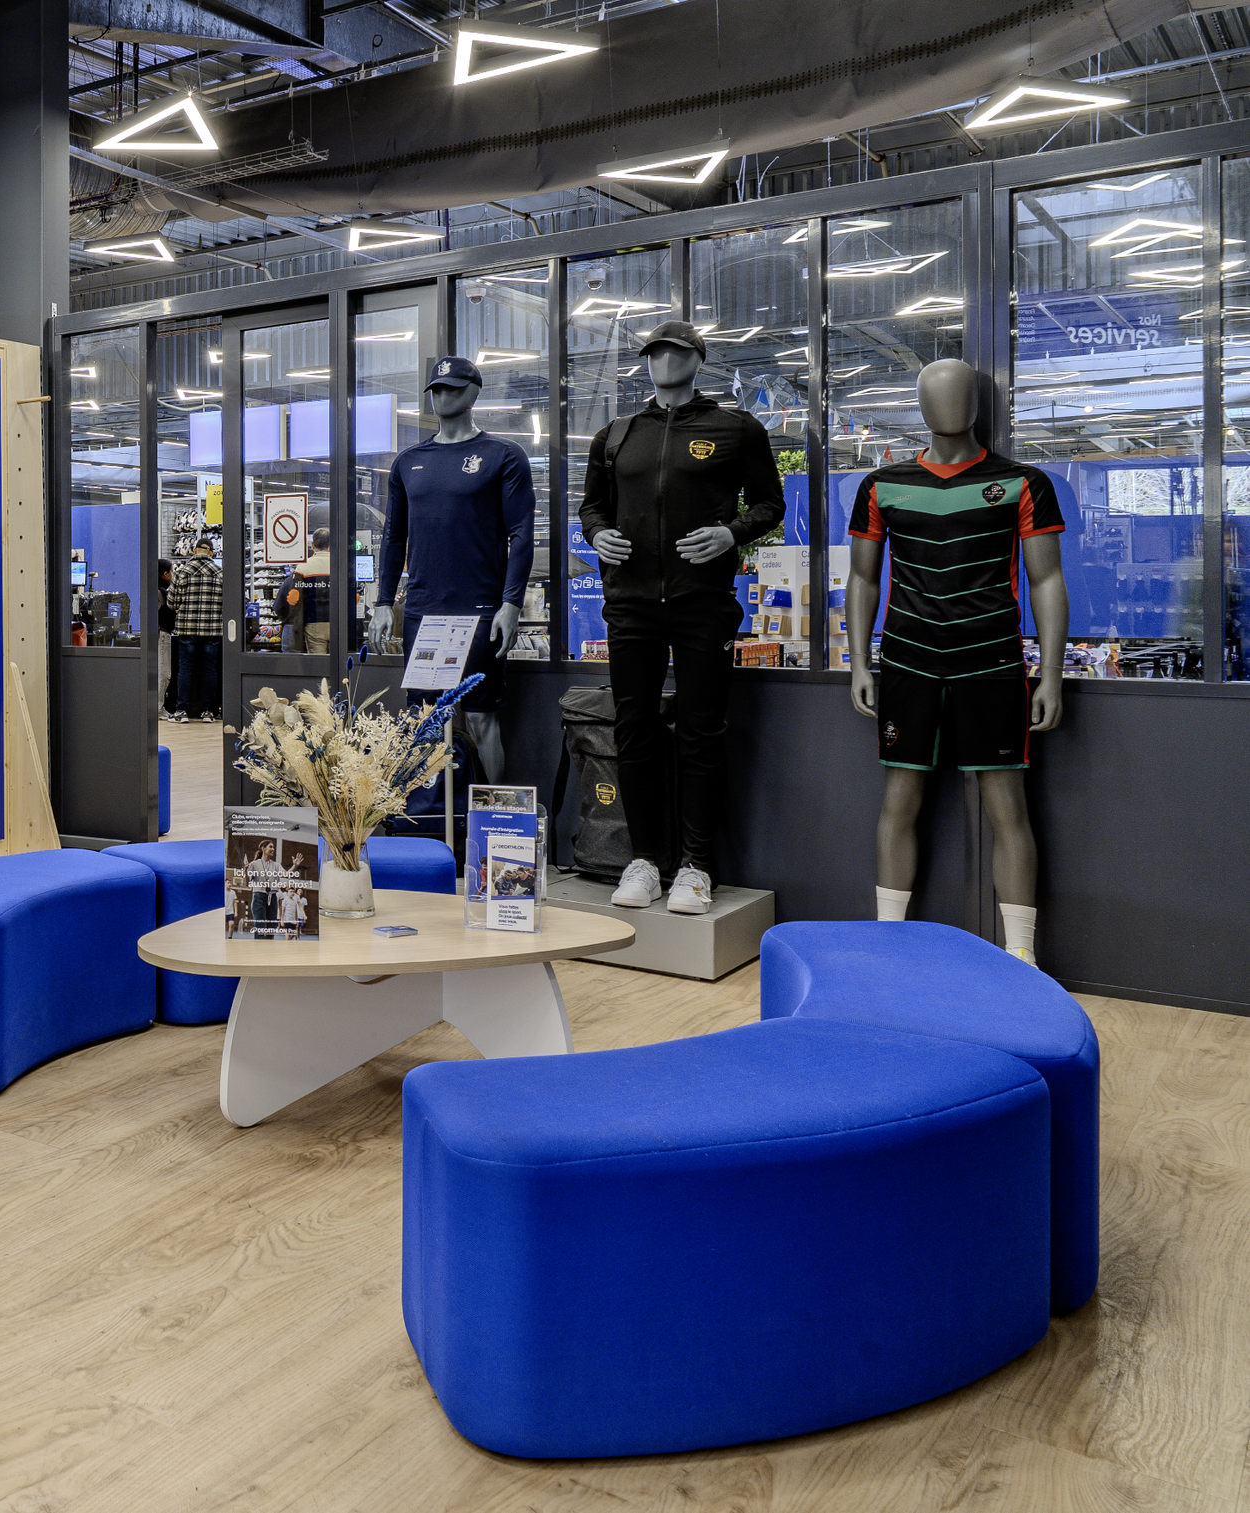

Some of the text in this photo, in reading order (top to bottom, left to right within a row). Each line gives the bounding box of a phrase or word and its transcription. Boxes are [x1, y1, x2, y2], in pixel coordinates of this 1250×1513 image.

[233, 868, 245, 878] Ici,
[260, 869, 300, 878] s'occupe
[248, 880, 270, 888] aussi
[271, 880, 287, 888] des
[289, 880, 308, 888] Pros
